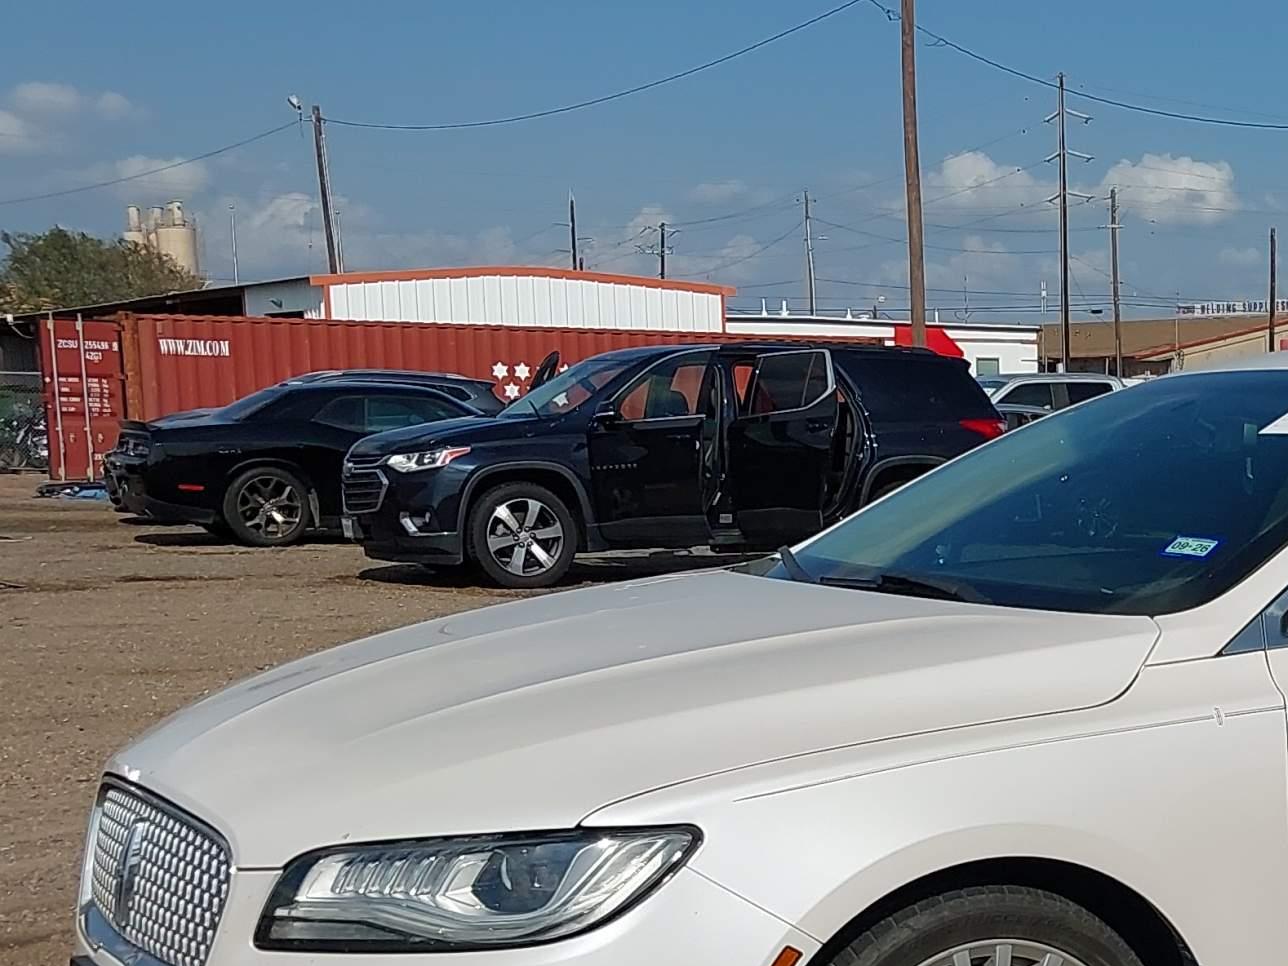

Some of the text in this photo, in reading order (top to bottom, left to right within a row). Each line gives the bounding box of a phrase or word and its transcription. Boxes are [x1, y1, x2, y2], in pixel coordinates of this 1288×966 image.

[1242, 300, 1286, 313] SUPPLES
[57, 339, 78, 349] ZCSU
[158, 338, 230, 357] WWW.ZIM.COM
